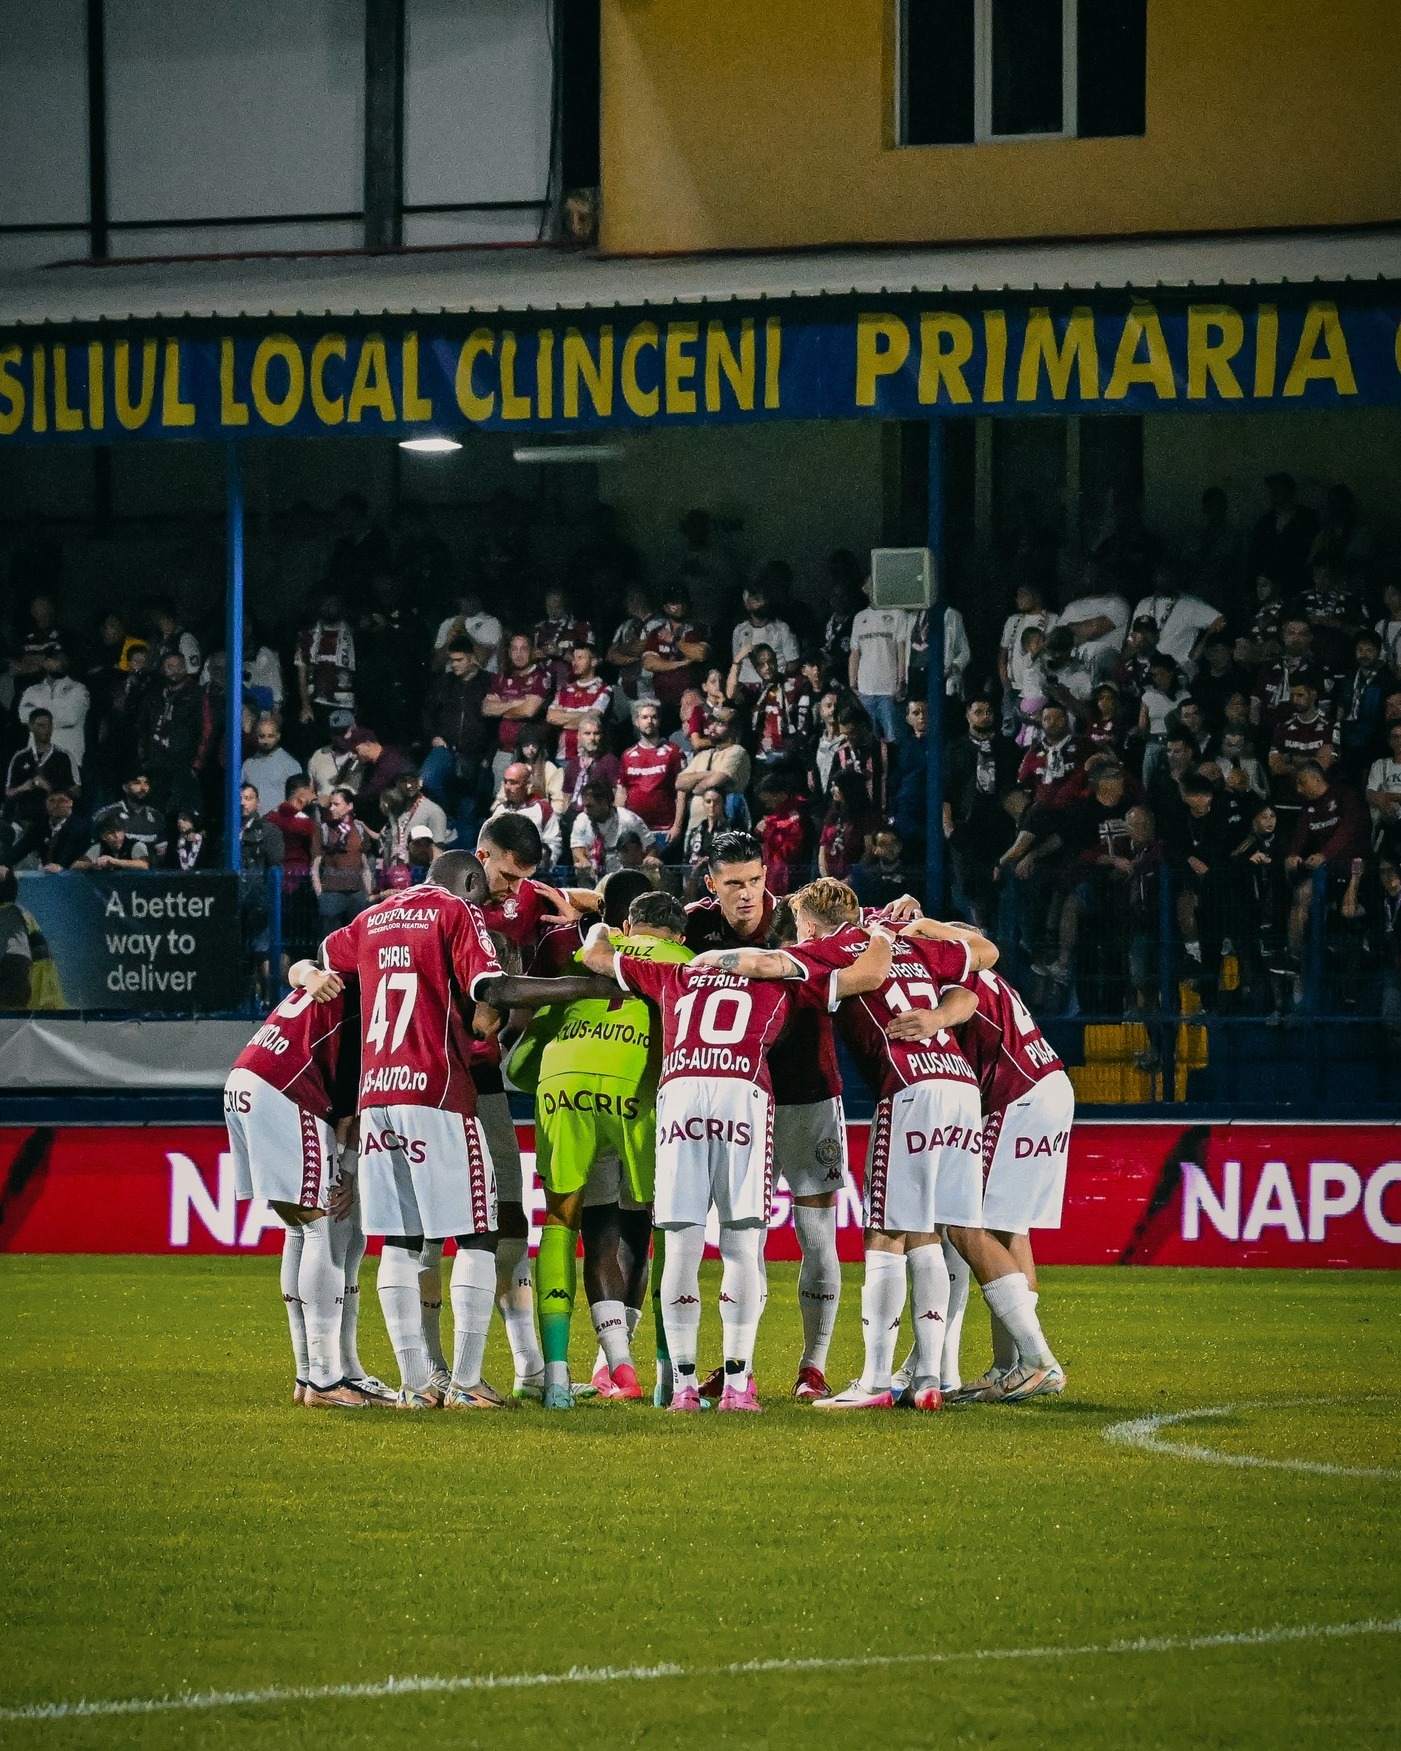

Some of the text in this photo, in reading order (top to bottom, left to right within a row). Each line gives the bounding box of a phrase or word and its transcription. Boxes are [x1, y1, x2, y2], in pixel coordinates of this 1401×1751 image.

[0, 337, 197, 434] SILIUL
[219, 331, 433, 427] LOCAL
[454, 318, 781, 422] CLINCENI
[105, 891, 215, 918] A better
[367, 907, 439, 928] HOFFMAN
[106, 929, 195, 960] way to
[378, 945, 411, 970] CHRIS
[107, 964, 196, 991] deliver
[366, 972, 418, 1055] 47
[674, 988, 753, 1049] 10
[556, 1020, 650, 1049] LUS-AUTO.ro
[543, 1089, 640, 1120] DACRIS
